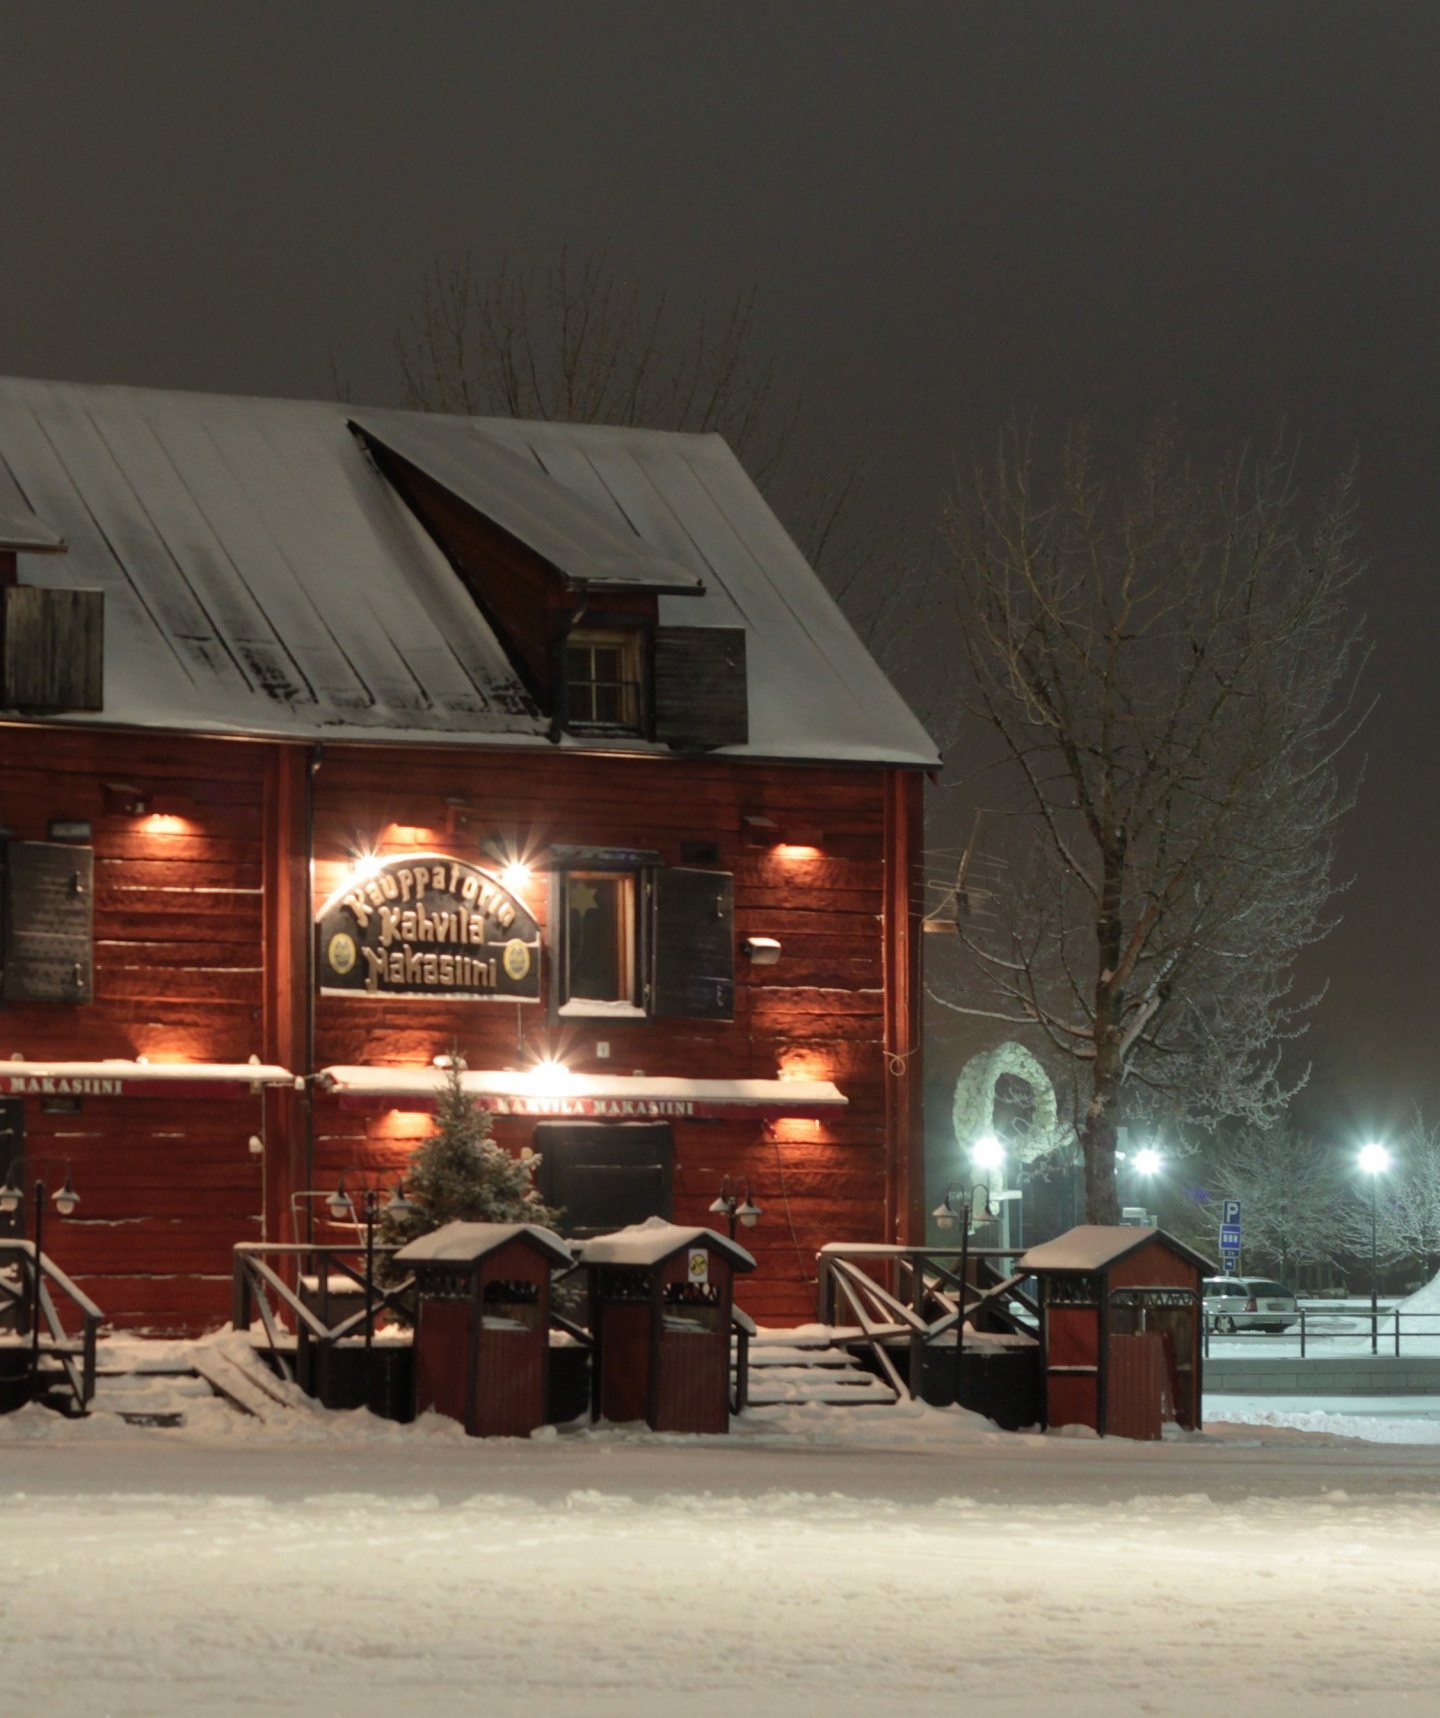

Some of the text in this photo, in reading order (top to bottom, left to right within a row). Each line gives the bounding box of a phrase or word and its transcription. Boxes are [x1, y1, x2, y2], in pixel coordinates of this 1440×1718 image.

[343, 863, 516, 928] Kauppatorin
[378, 902, 485, 946] Kahvila
[362, 944, 497, 993] Makasiini
[11, 1077, 123, 1096] MAKASIINI
[593, 1099, 694, 1116] MAKASIINI
[1226, 1202, 1239, 1223] P
